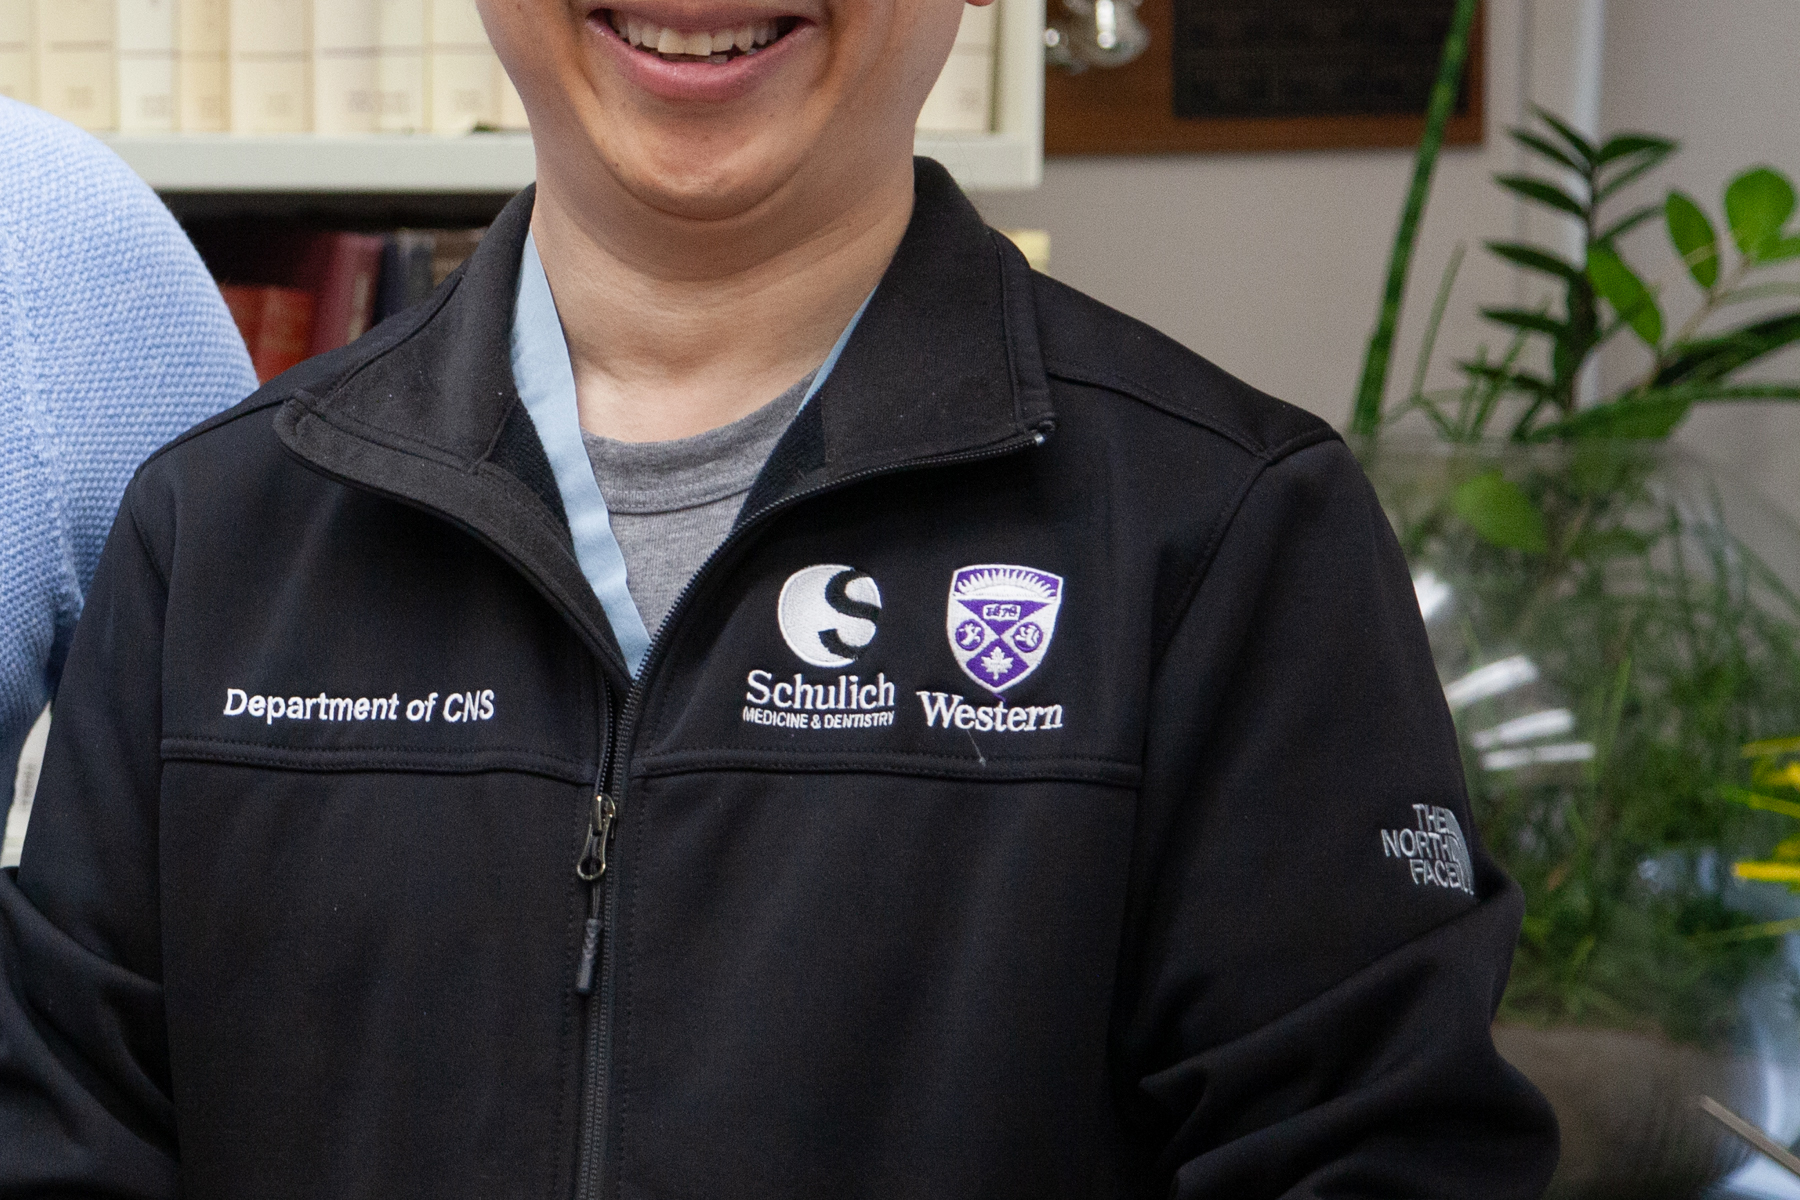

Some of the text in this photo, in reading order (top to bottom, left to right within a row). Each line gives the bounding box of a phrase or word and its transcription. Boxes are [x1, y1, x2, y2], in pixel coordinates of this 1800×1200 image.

[984, 605, 1019, 619] 1878
[746, 668, 896, 711] Schulich
[222, 687, 496, 726] Department of CNS
[742, 705, 896, 730] MEDICINE & DENTISTRY
[915, 690, 1064, 732] Western
[1411, 803, 1450, 833] THE
[1380, 827, 1453, 863] NORTH
[1408, 858, 1462, 889] FACE
